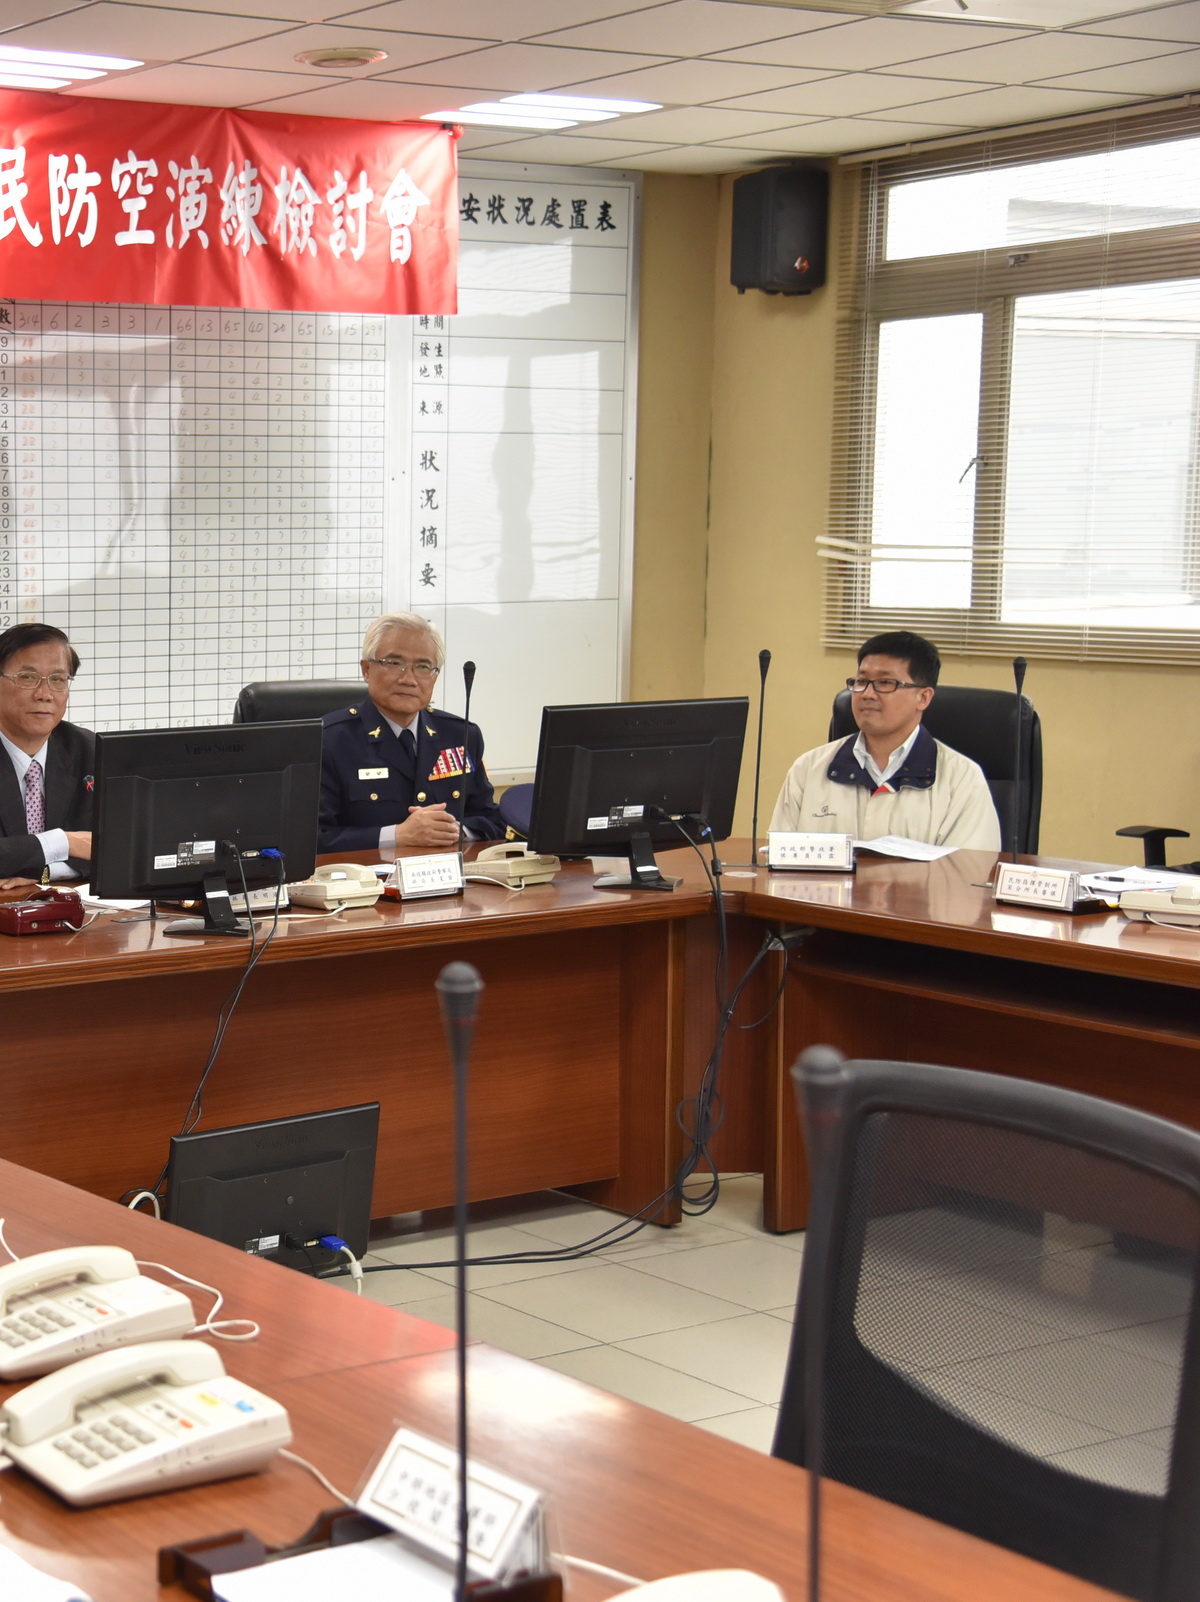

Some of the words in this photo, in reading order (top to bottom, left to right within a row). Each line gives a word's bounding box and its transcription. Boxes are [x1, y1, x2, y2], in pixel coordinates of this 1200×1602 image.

[460, 193, 617, 233] 安狀況處置表
[420, 343, 443, 358] 發生
[419, 364, 444, 378] 地點
[419, 401, 443, 415] 來源
[419, 450, 440, 588] 狀況摘要
